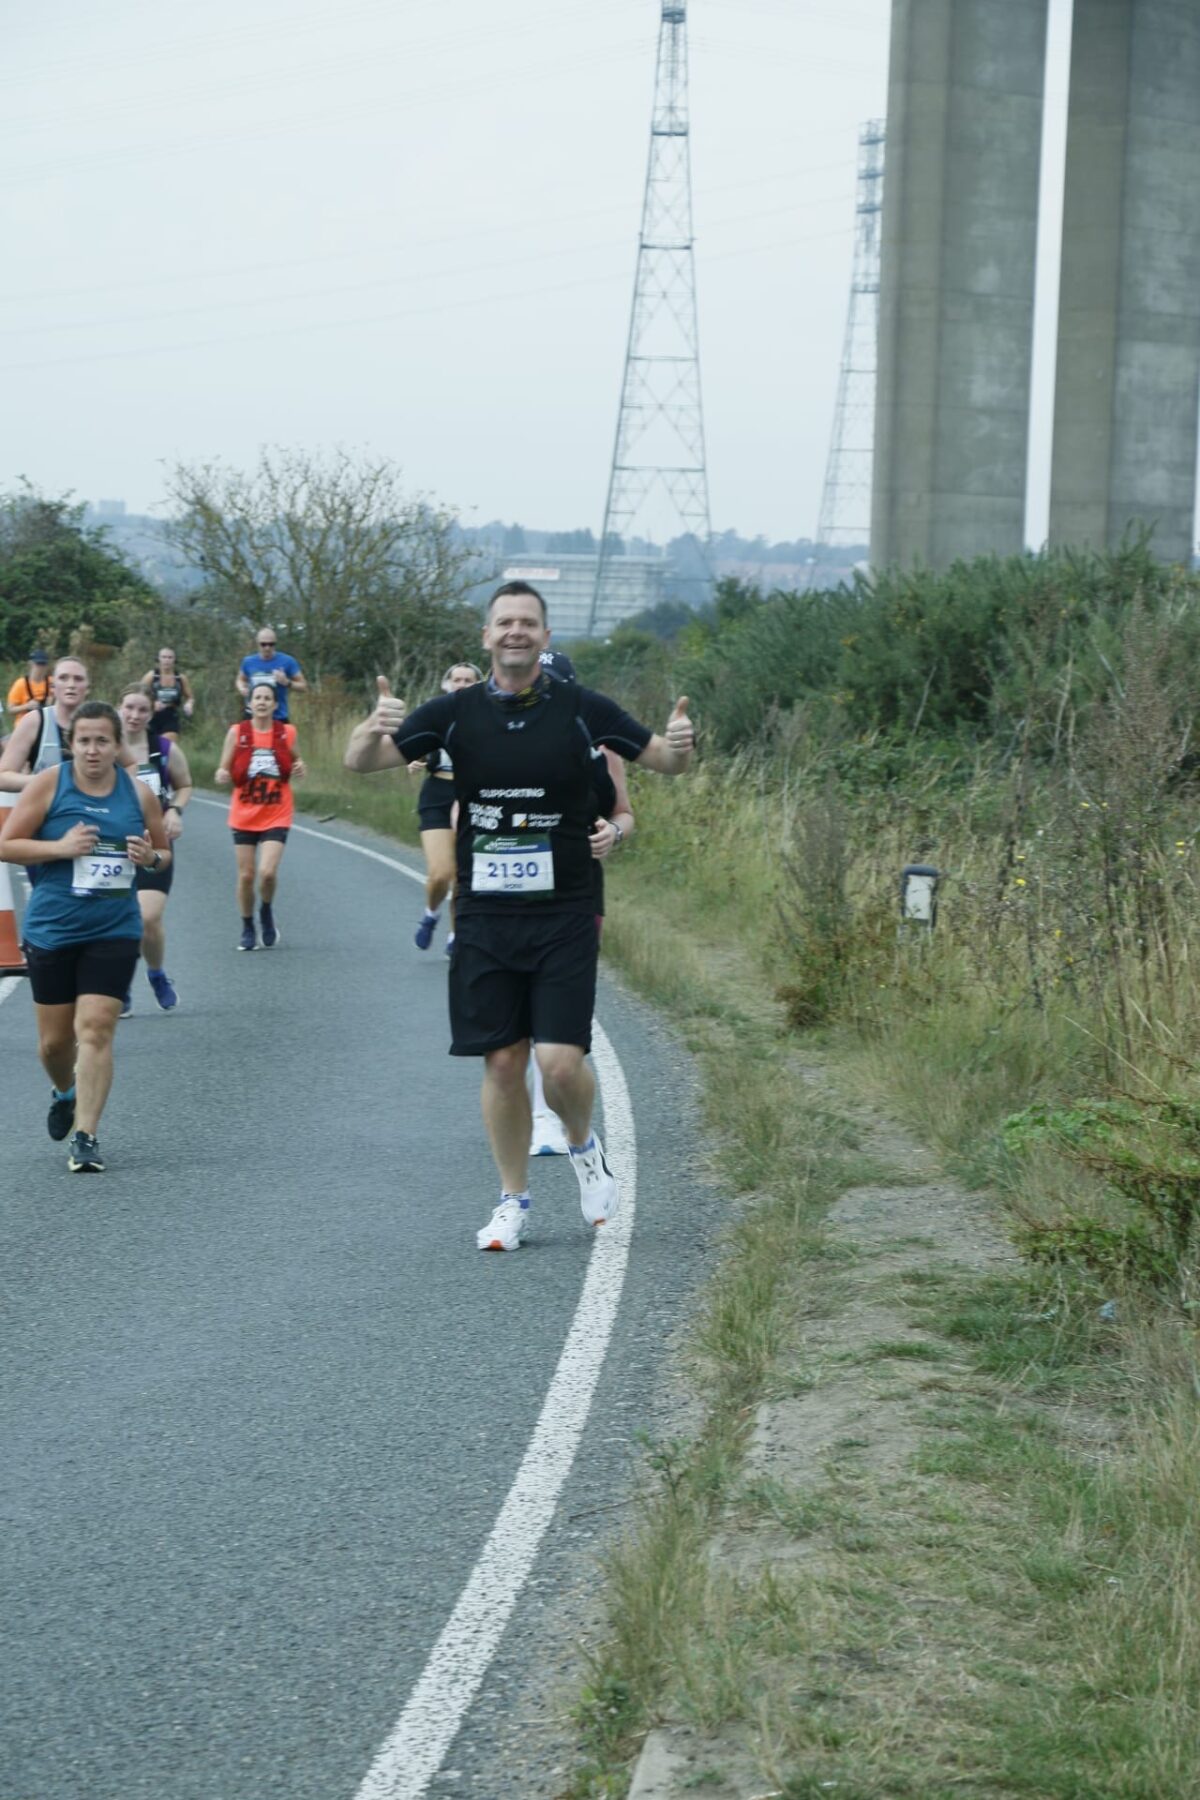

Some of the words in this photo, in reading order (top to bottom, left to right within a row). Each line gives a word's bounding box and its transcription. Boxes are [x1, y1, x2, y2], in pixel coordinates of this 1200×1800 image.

[479, 788, 545, 798] SUPPORTING
[91, 863, 122, 877] 739
[488, 861, 538, 878] 2130
